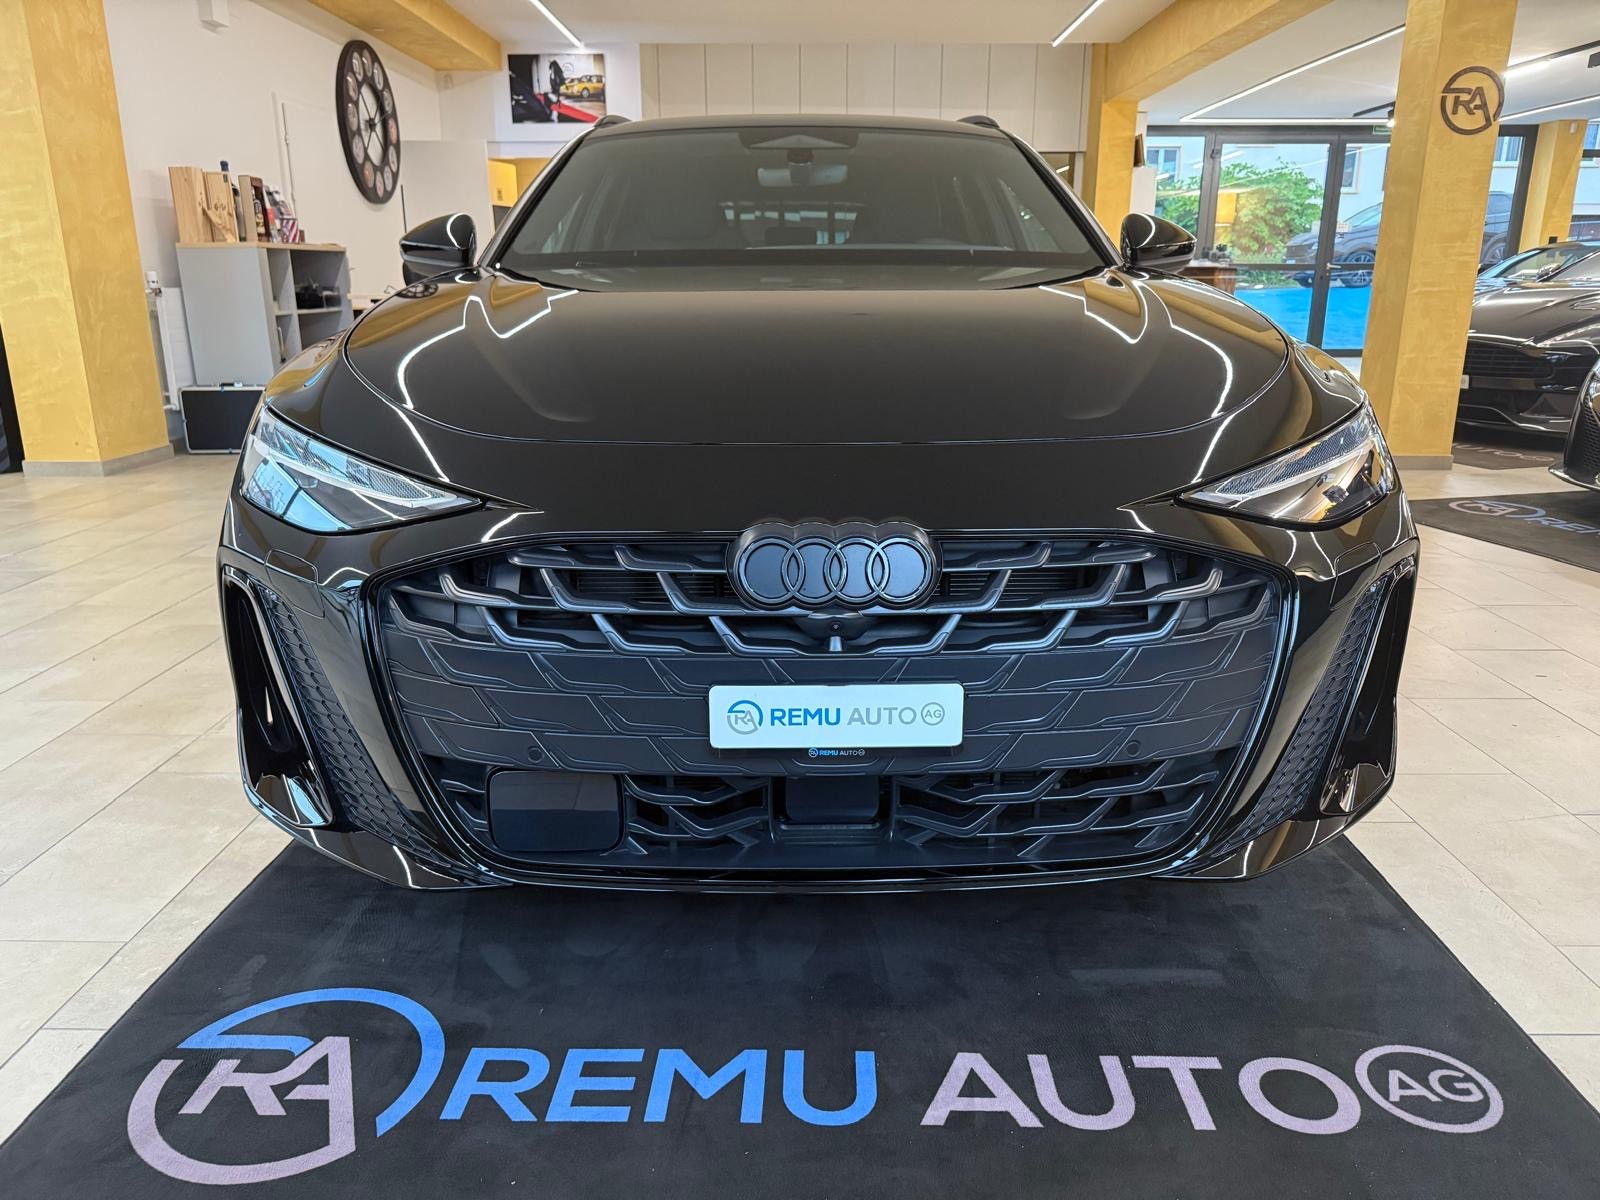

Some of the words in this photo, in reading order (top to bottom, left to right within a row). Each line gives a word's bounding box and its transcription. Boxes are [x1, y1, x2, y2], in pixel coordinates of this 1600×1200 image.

[770, 707, 841, 726] REMU
[847, 706, 917, 726] AUTO
[439, 1047, 878, 1126] REMU
[920, 1052, 1361, 1135] AUTO
[1388, 1068, 1485, 1103] AG
